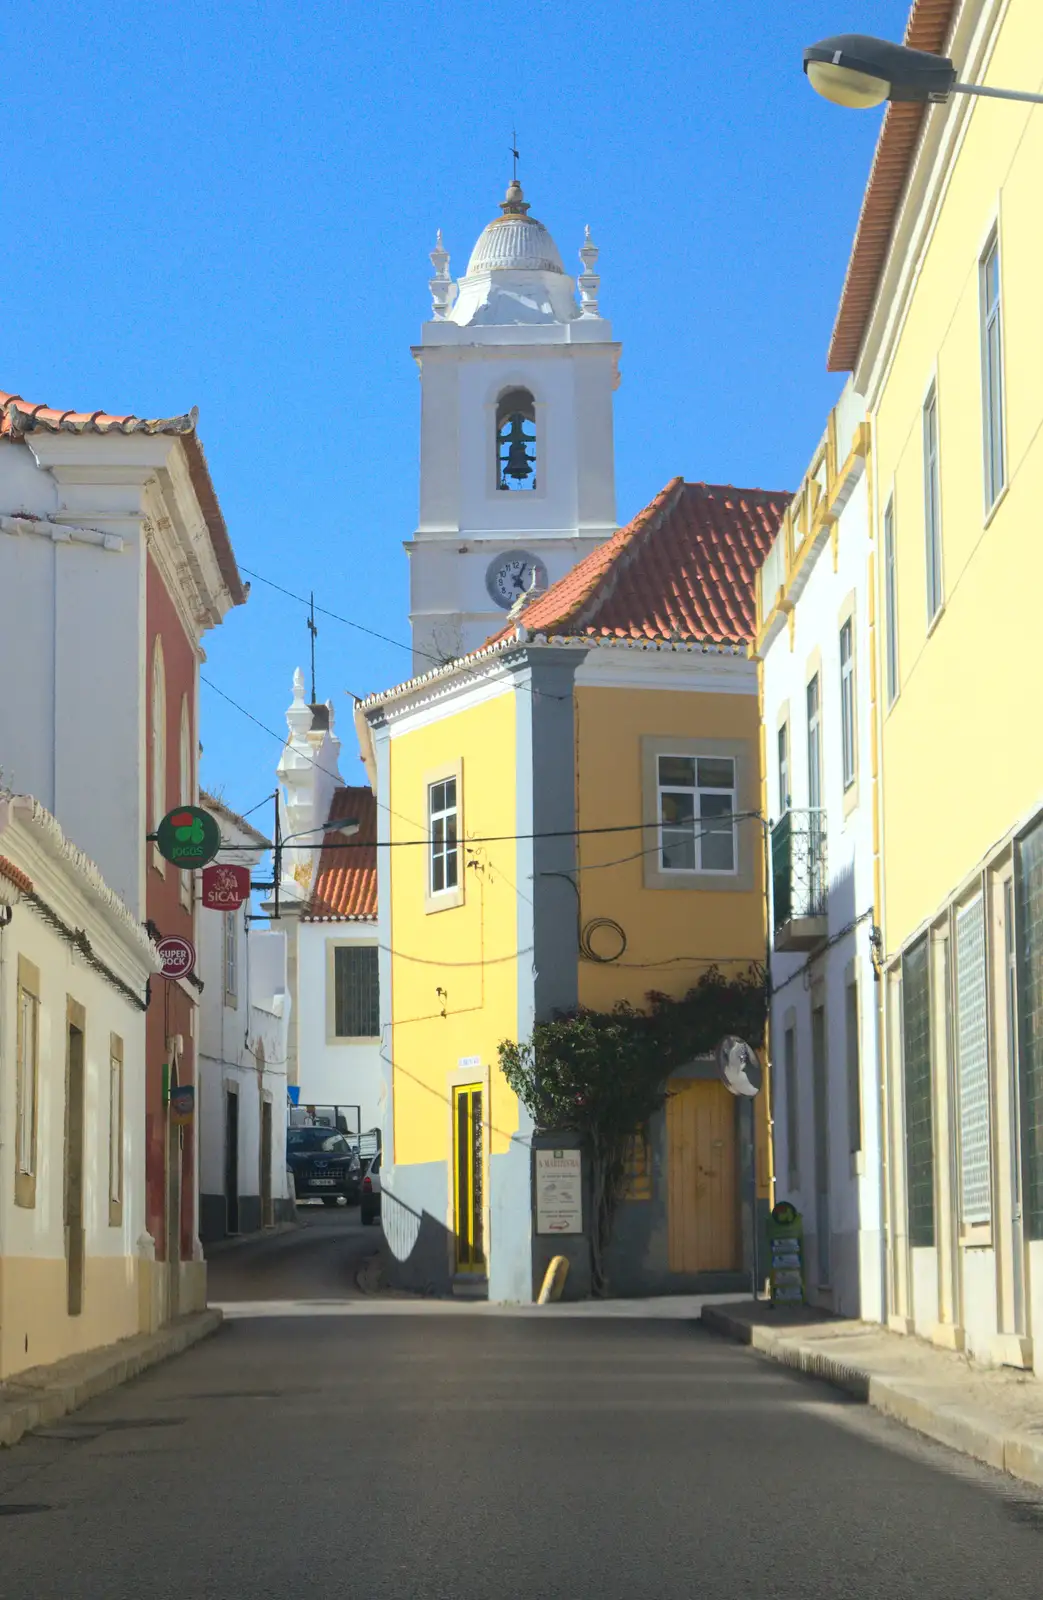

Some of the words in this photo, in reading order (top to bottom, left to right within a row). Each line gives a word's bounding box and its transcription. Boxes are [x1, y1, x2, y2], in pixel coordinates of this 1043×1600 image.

[512, 561, 520, 569] 12
[172, 846, 204, 859] JOGOS
[207, 891, 242, 902] SICAL
[160, 950, 187, 958] SUPER
